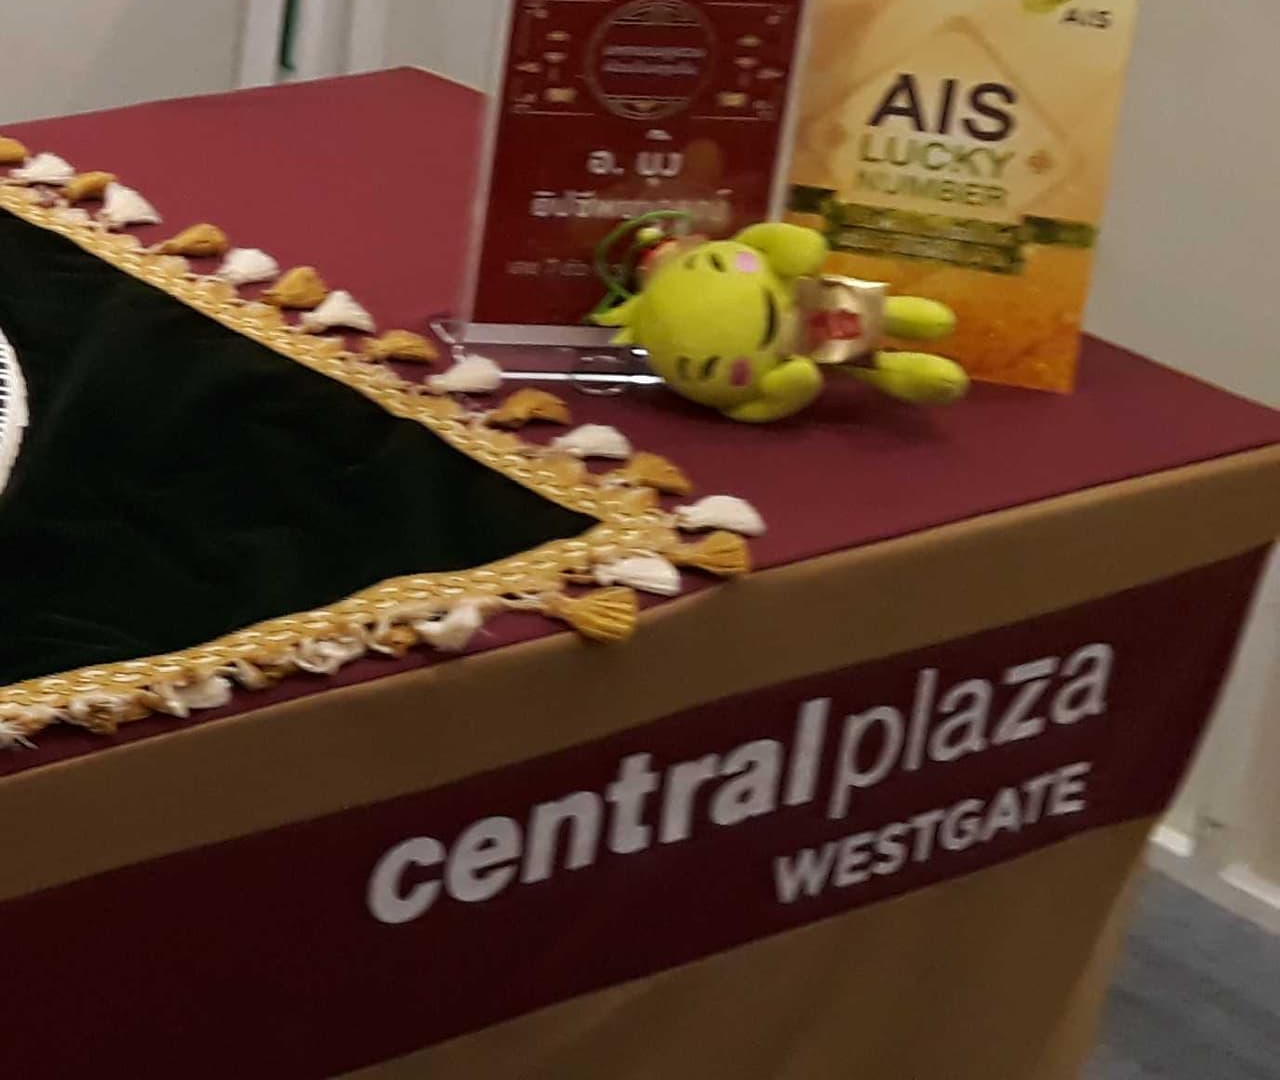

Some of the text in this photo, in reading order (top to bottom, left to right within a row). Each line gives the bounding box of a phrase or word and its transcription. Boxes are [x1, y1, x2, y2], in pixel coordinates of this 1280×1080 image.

[1059, 6, 1112, 30] AIS
[865, 72, 1019, 143] AIS
[858, 131, 1017, 179] LUCKY
[852, 167, 1010, 209] NUMBER
[774, 761, 1093, 904] WESTGATE
